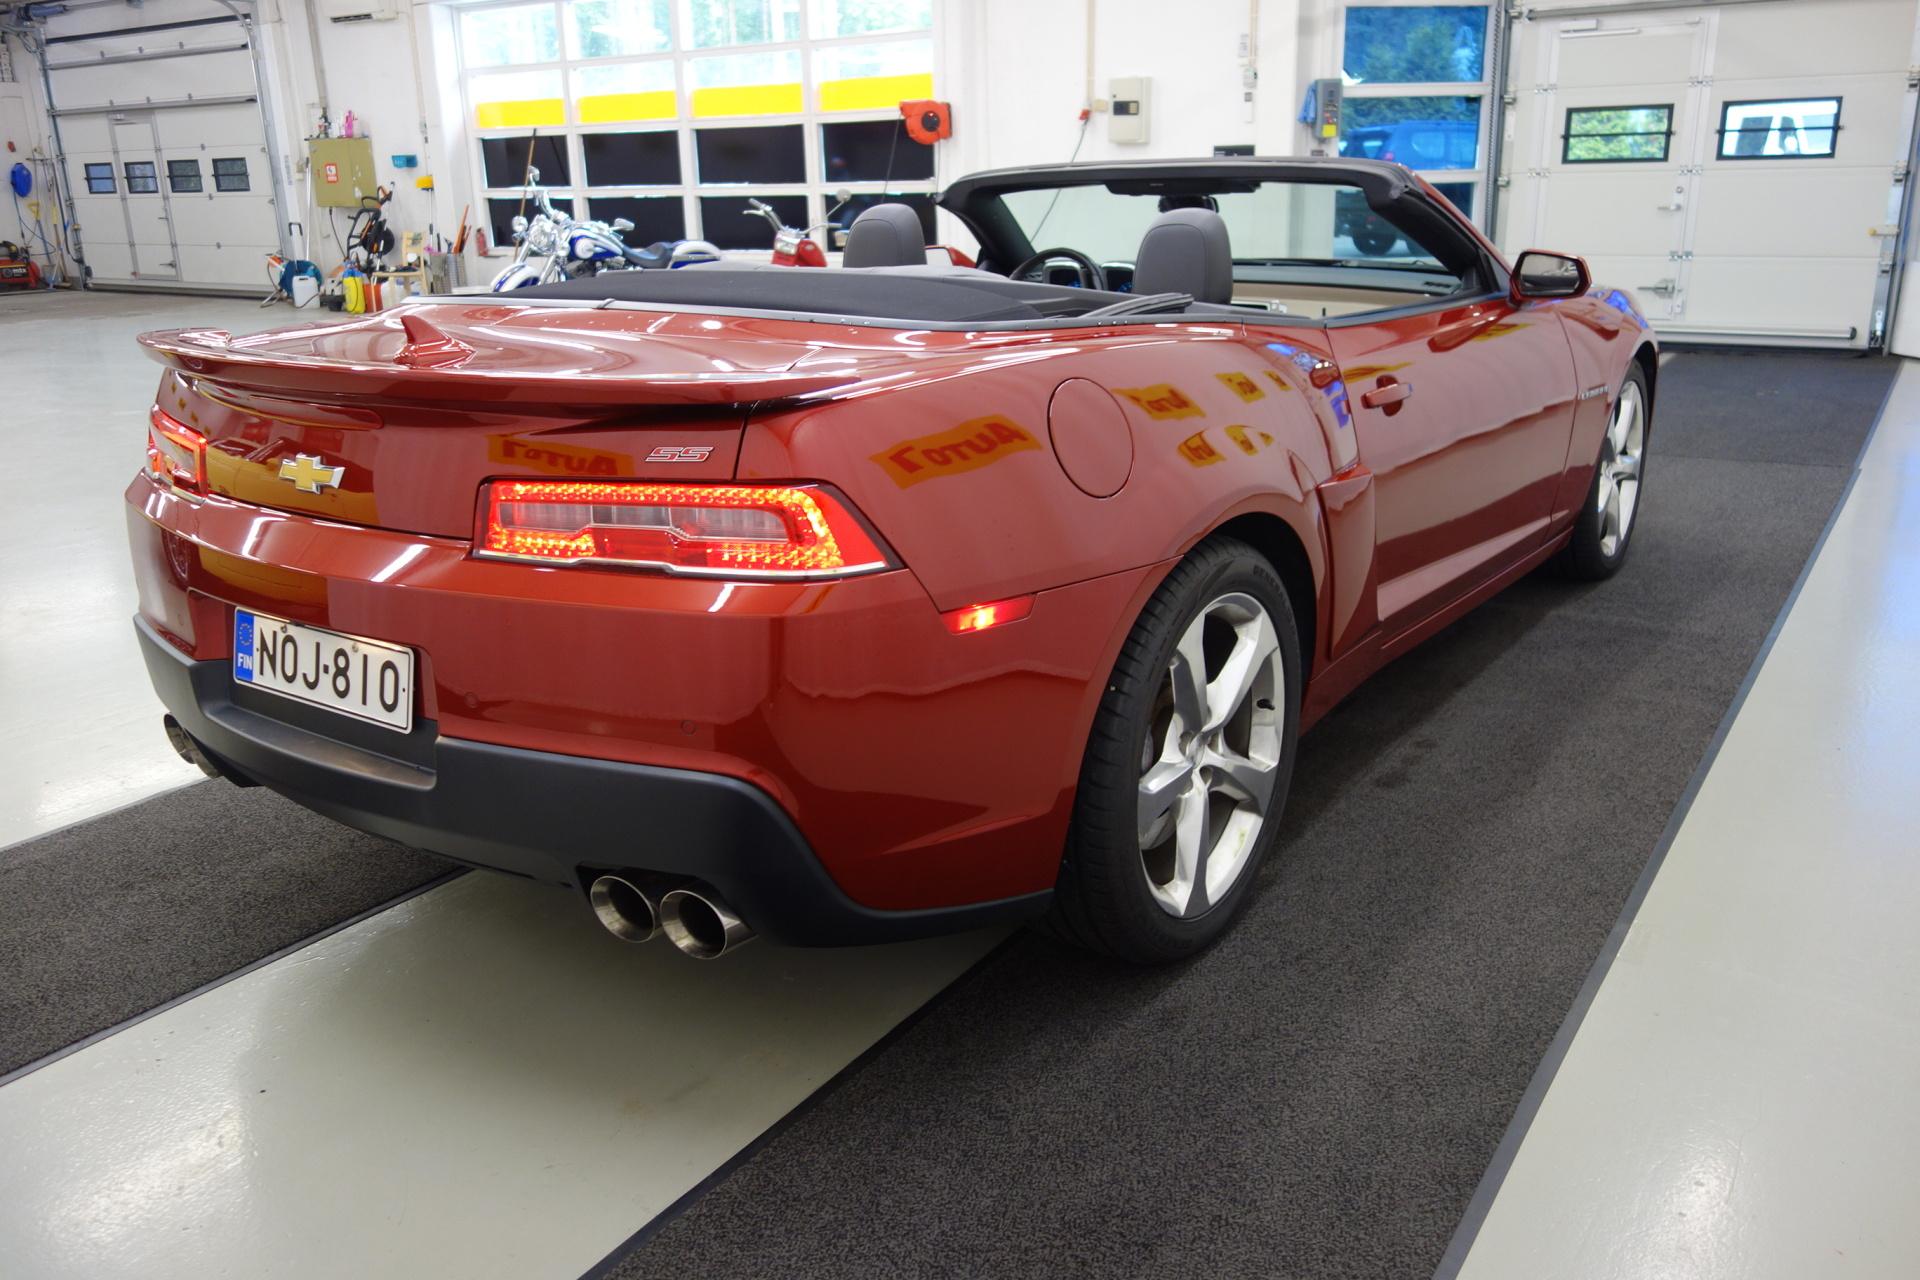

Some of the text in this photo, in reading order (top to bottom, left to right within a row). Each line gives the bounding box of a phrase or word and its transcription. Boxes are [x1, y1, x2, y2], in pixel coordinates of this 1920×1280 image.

[645, 446, 714, 462] SS
[237, 653, 253, 670] FIN
[259, 627, 399, 713] NOJ-810
